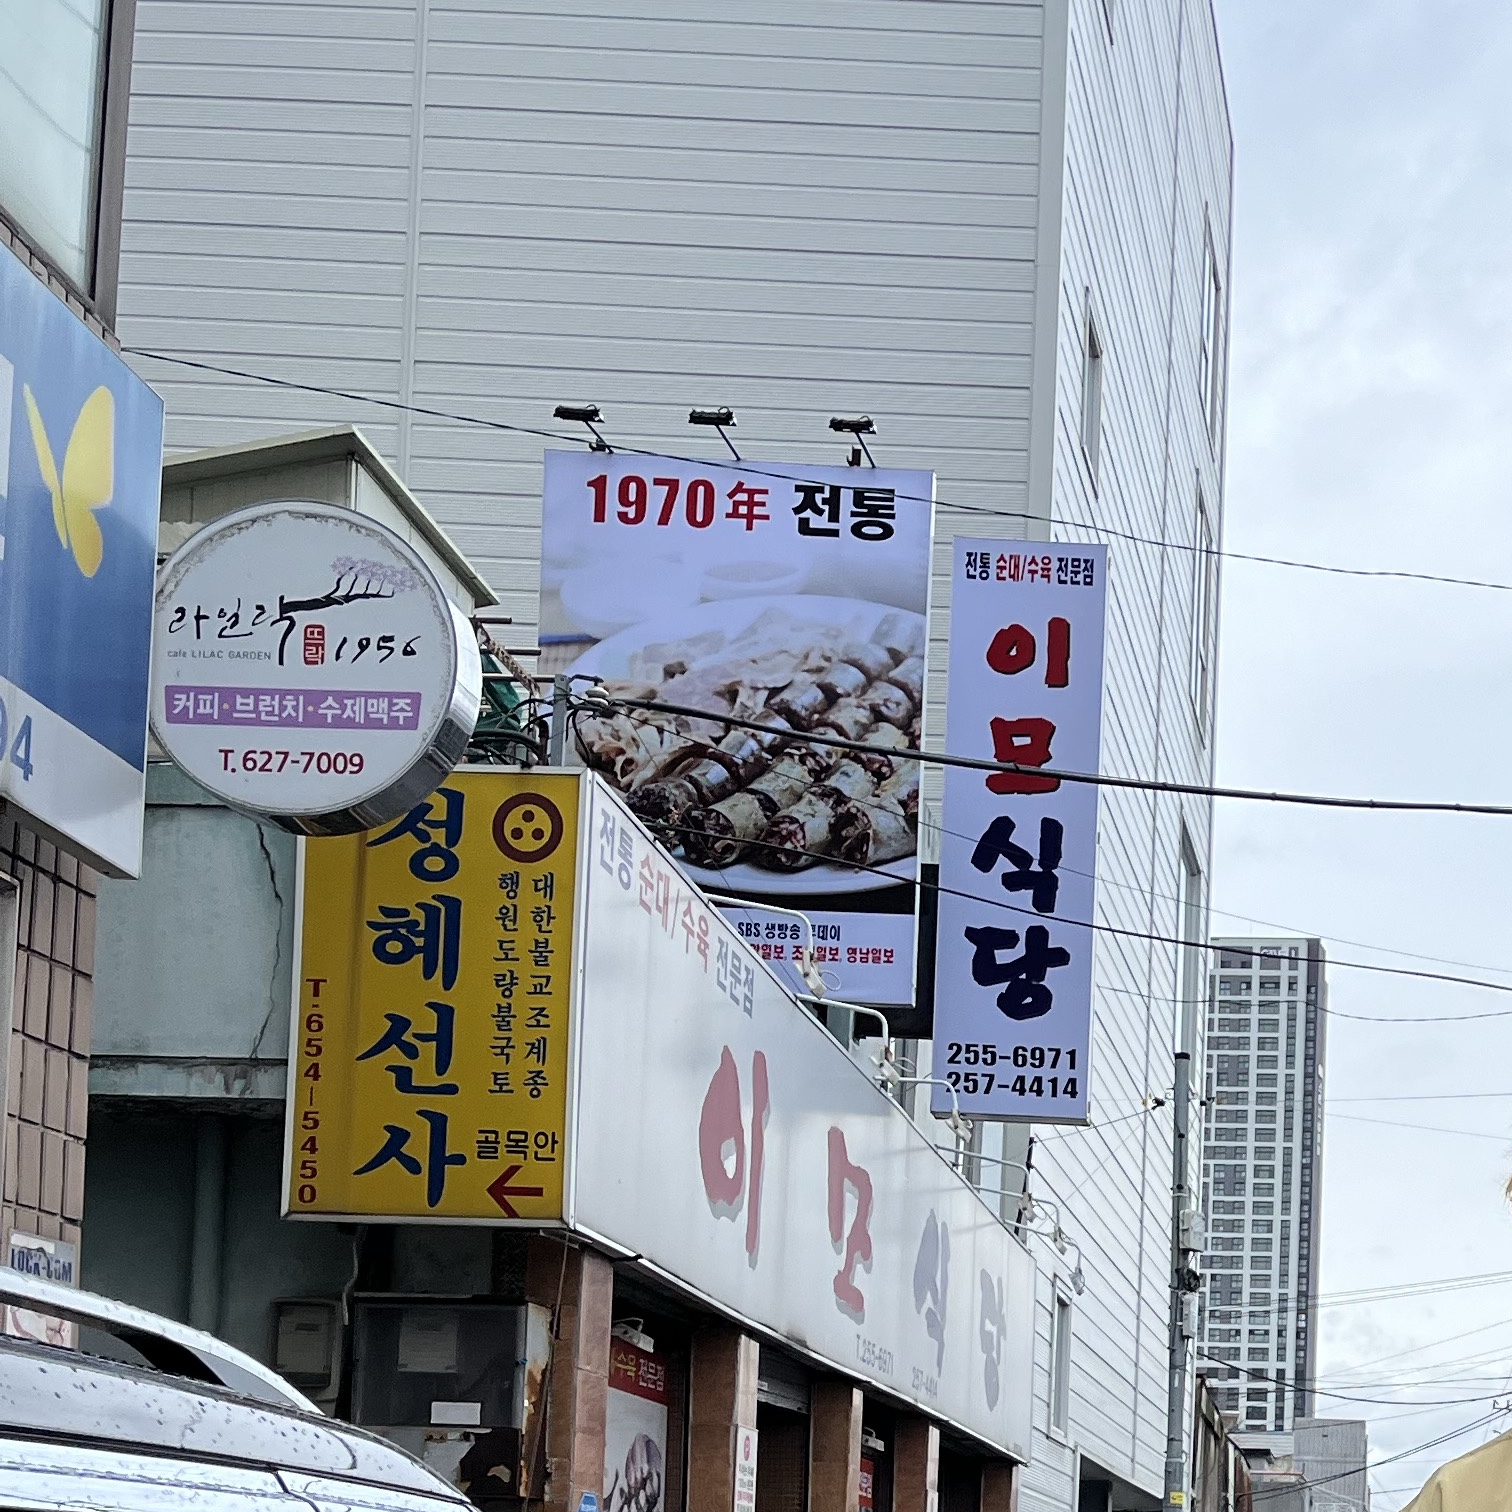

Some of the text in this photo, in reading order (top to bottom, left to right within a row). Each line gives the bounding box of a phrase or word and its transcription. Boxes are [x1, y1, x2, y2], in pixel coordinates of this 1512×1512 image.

[791, 484, 897, 542] 전통
[965, 550, 1095, 587] 전통 순대/수육 전문점
[167, 594, 298, 667] 라일락
[304, 624, 325, 665] 뜨락
[335, 634, 422, 664] 1956
[191, 650, 224, 660] LILAC
[227, 650, 272, 661] GARDEN
[965, 616, 1071, 1021] 이모식당
[600, 807, 755, 1020] 전통 순대/수육 전문점
[738, 921, 761, 939] SBS
[764, 922, 800, 940] 생방송
[791, 945, 842, 963] 조일보,
[846, 947, 895, 965] 영남일보
[487, 869, 522, 1096] 행원도량불국토
[522, 870, 557, 1100] 대한불교조계종
[947, 1042, 1078, 1071] 255-6971
[945, 1071, 1079, 1099] 257-4414
[475, 1128, 559, 1162] 골목안
[698, 1045, 1007, 1412] 이모식당
